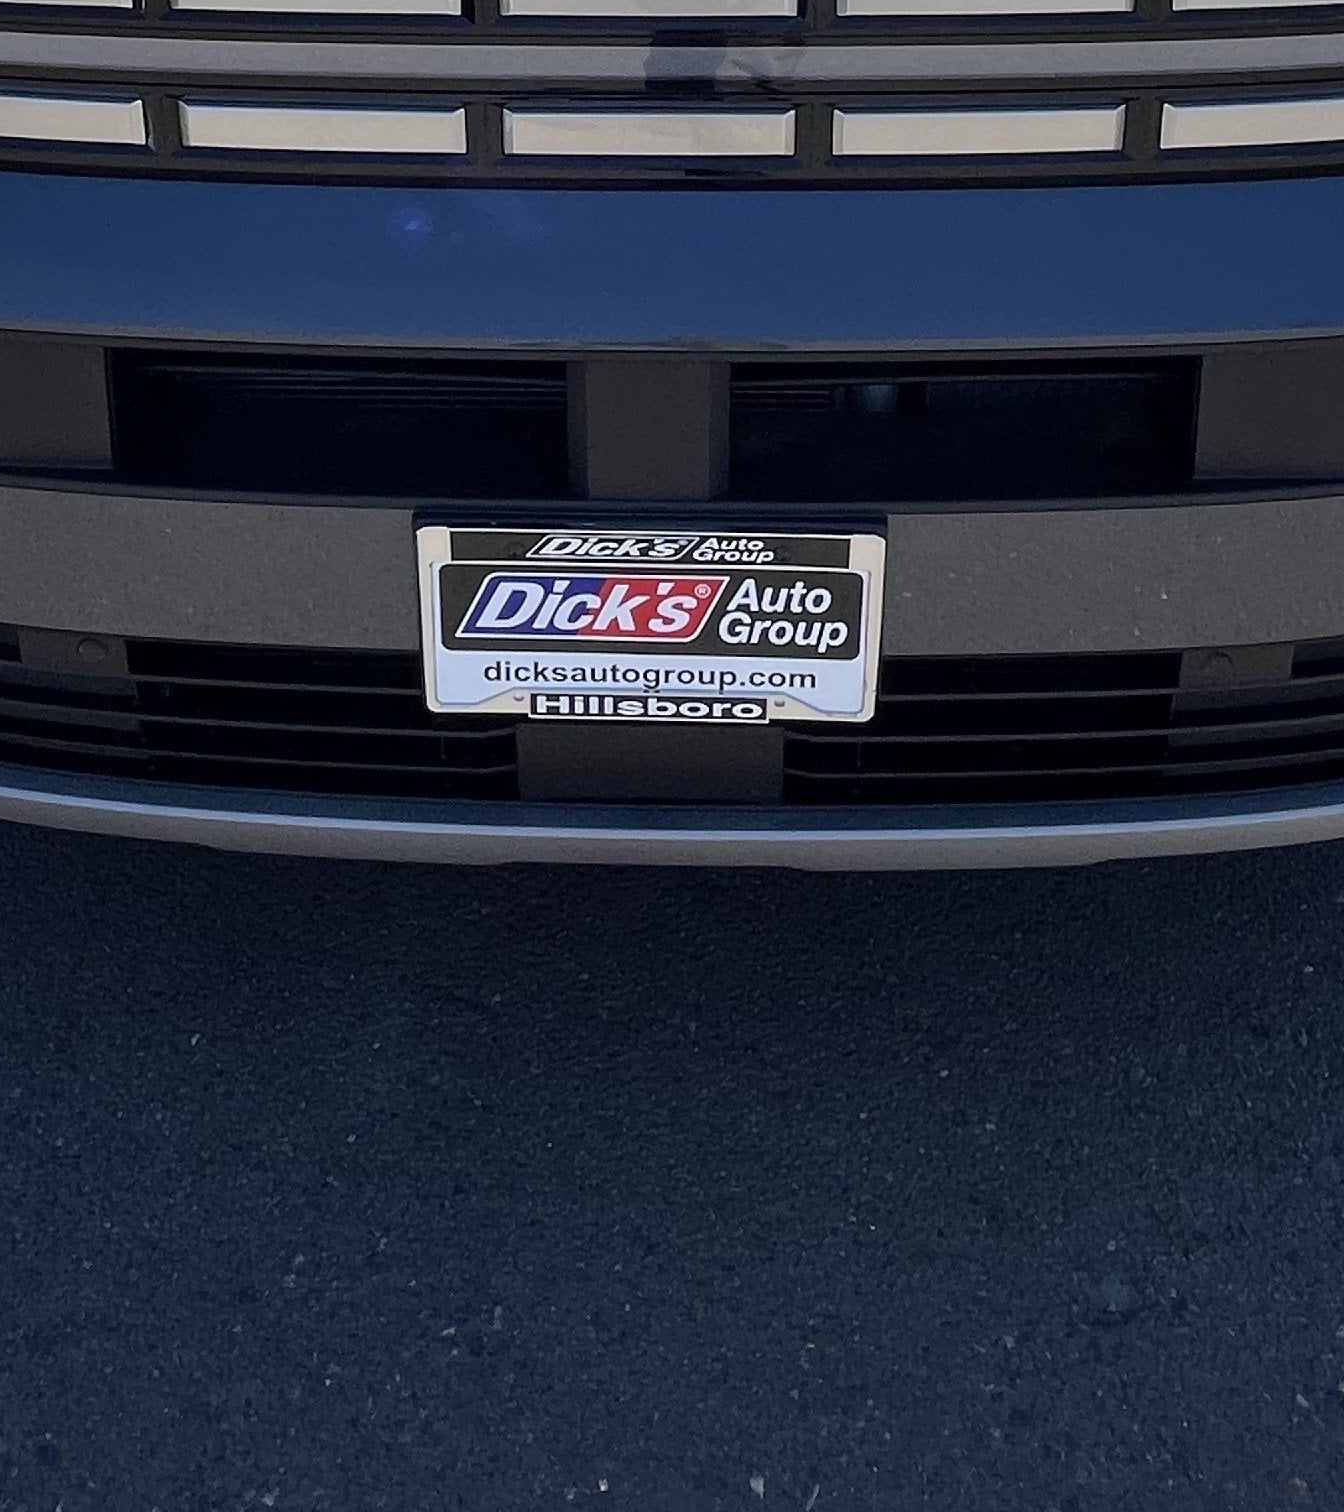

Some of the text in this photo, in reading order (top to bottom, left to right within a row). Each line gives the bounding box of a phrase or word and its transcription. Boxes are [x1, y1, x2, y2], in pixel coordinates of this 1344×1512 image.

[538, 536, 681, 559] Dick's
[692, 548, 774, 564] Group
[703, 537, 764, 552] Auto
[475, 578, 698, 634] Dick's
[725, 577, 832, 614] Auto
[718, 611, 849, 654] Group
[483, 661, 817, 693] dicksautogroup.com
[535, 695, 764, 719] Hillsboro
